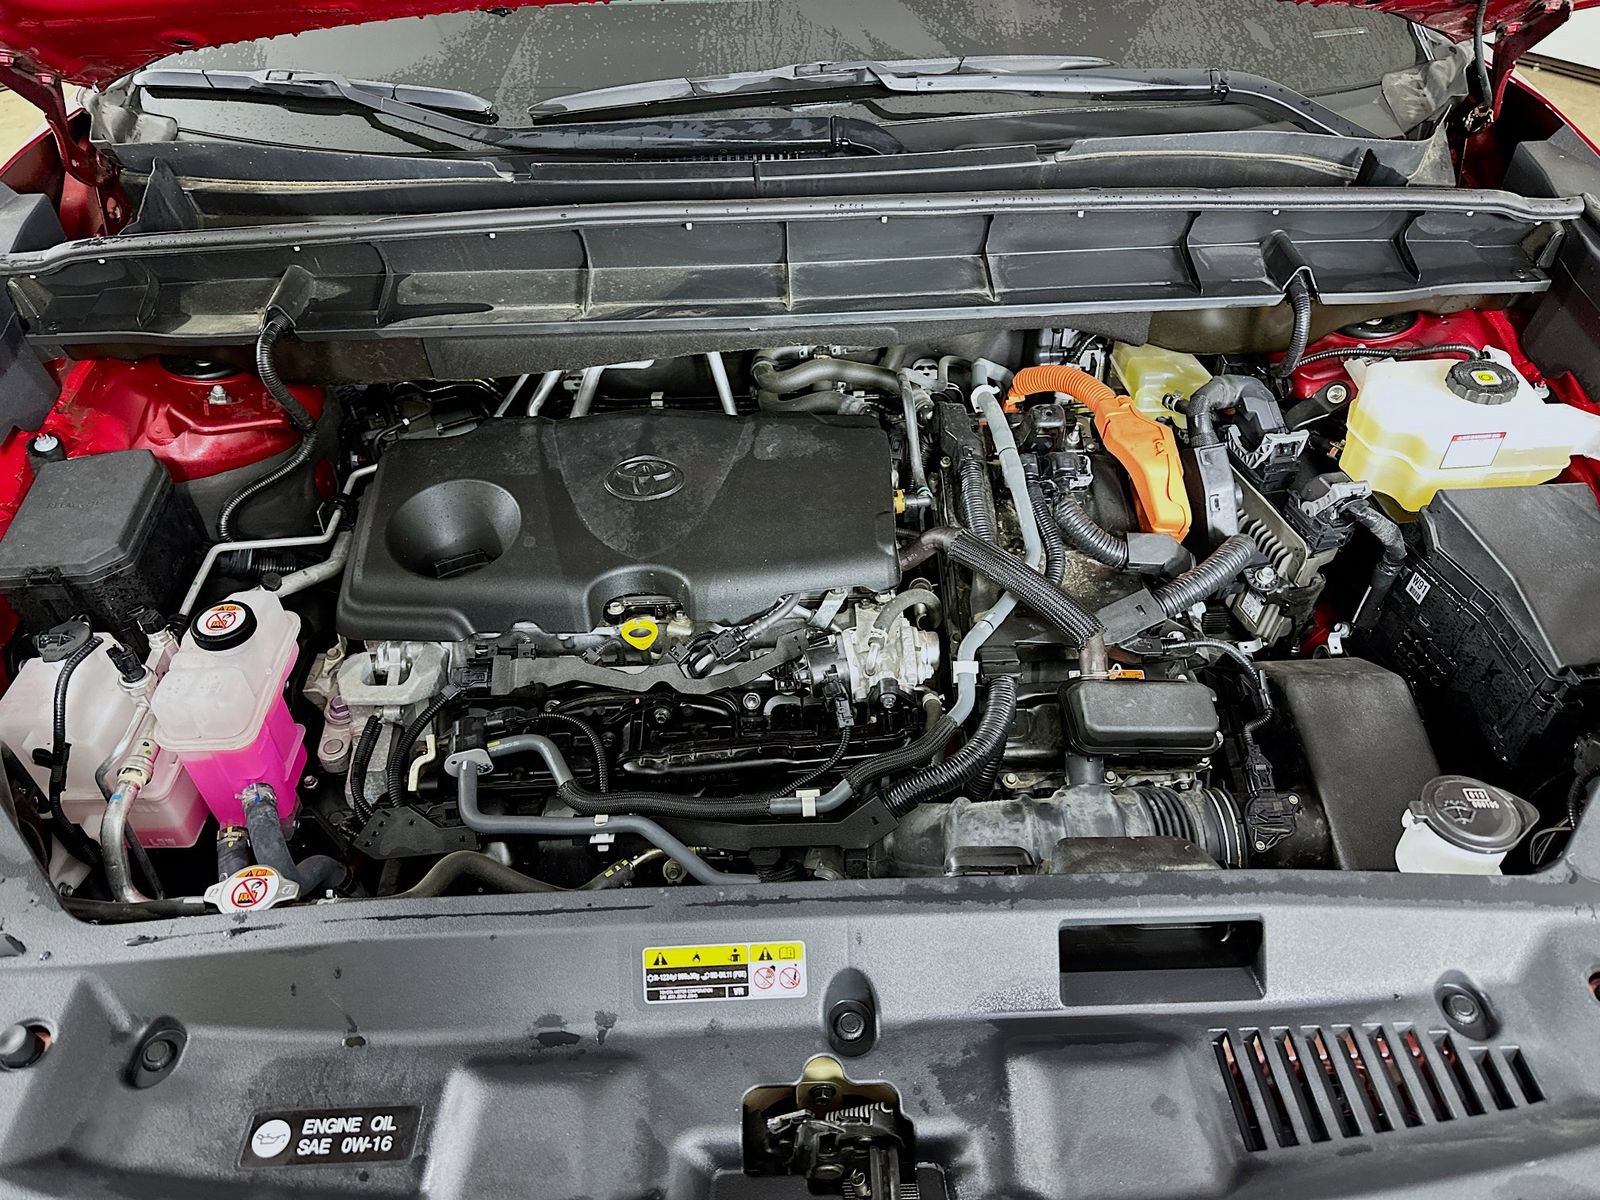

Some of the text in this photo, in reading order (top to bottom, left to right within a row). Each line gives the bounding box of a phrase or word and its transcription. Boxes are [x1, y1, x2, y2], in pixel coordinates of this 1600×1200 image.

[302, 1115, 397, 1135] ENGINE OIL
[297, 1136, 393, 1156] SAE 0W-16
